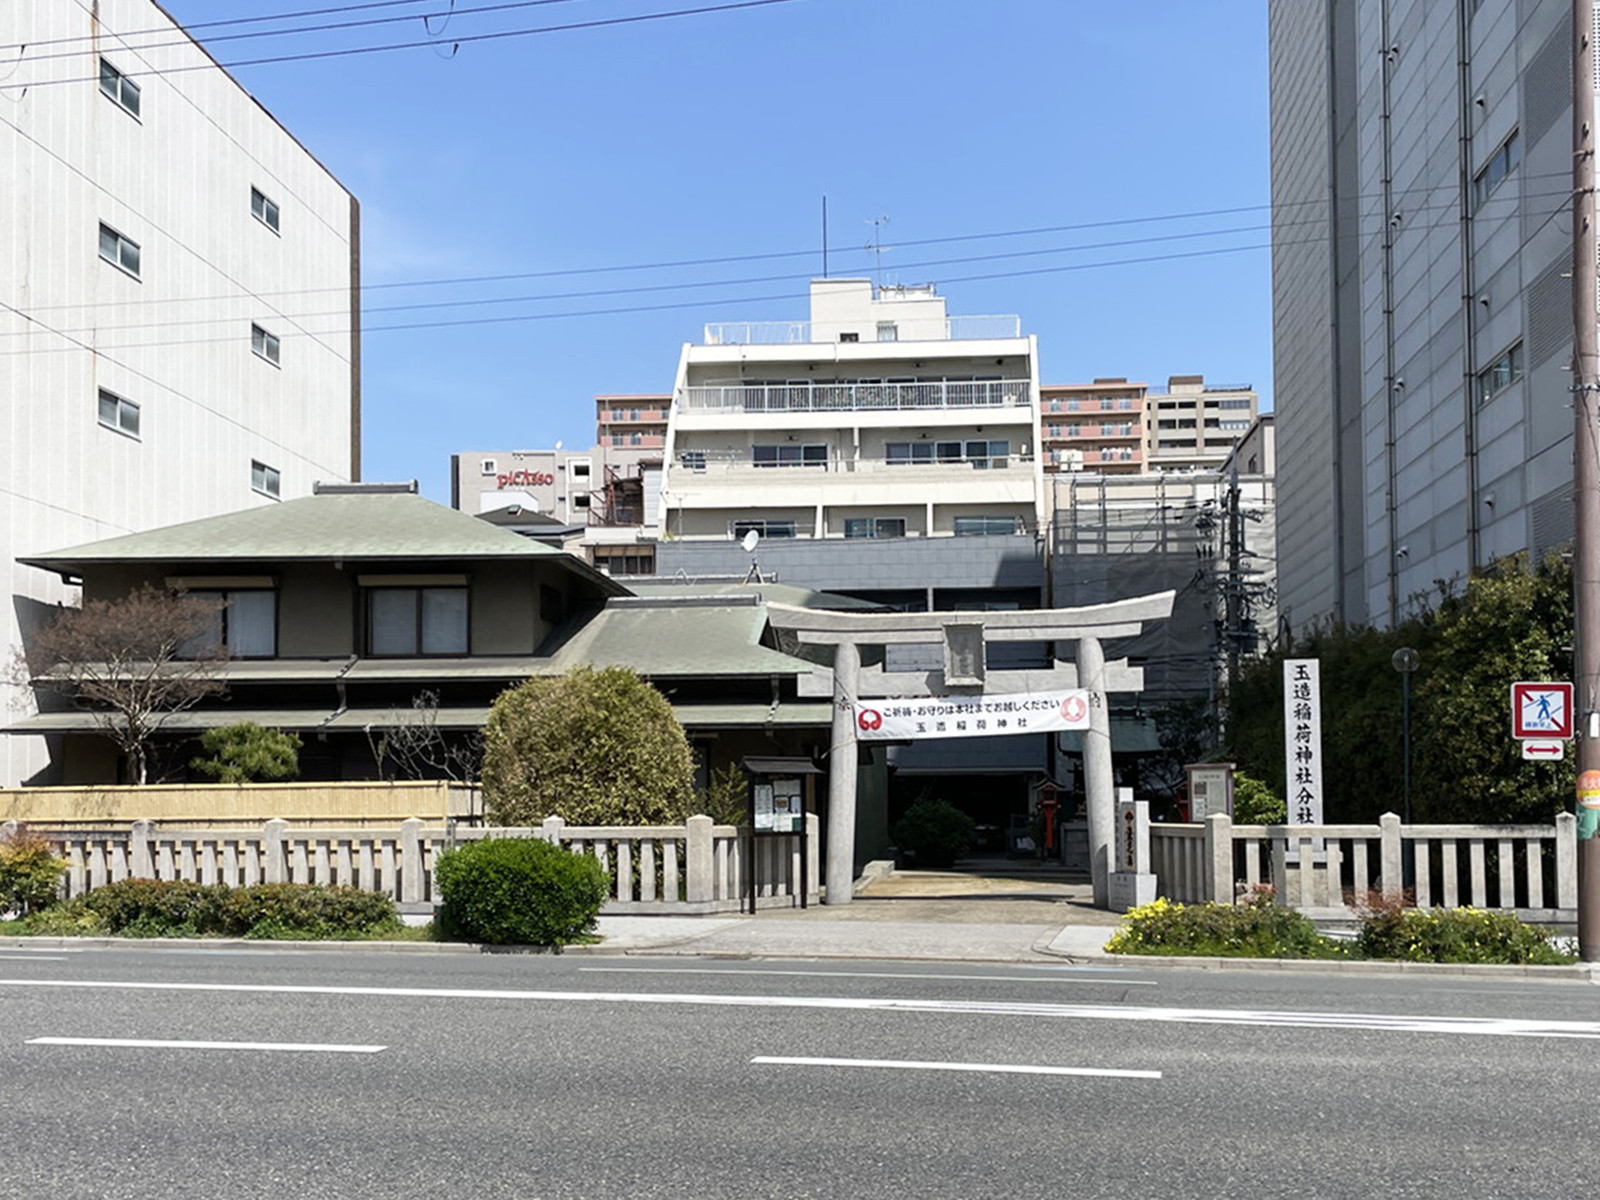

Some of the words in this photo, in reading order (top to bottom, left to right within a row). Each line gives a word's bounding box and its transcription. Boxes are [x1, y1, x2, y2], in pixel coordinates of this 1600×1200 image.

[916, 718, 1028, 734] 玉造稲荷神社
[1293, 664, 1315, 825] 玉造稲荷神社分社
